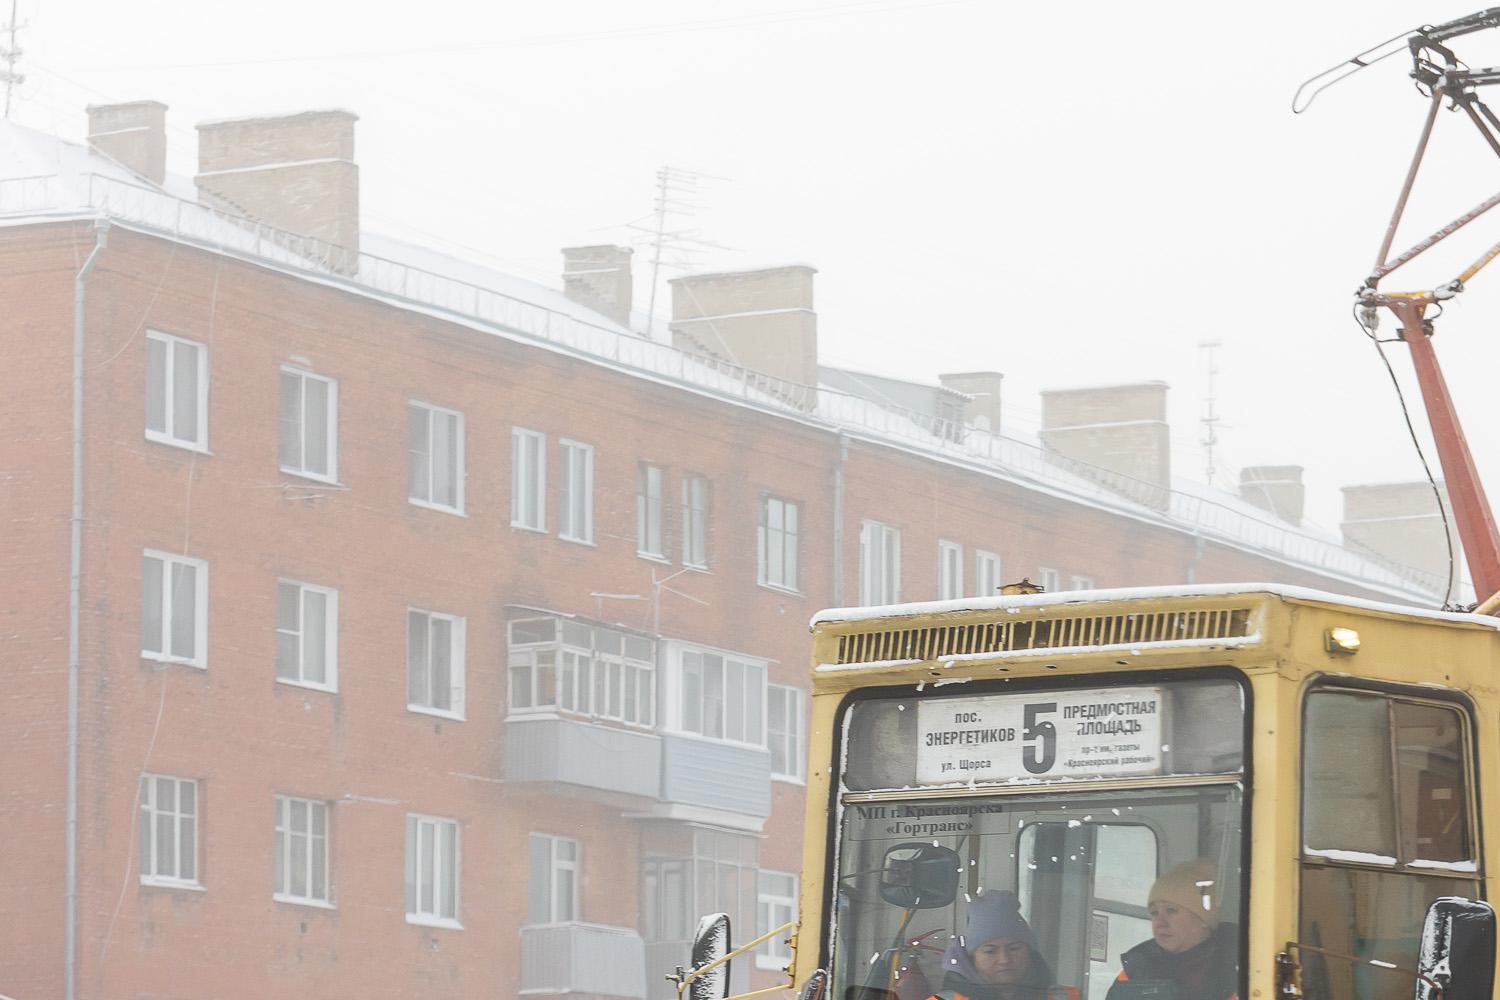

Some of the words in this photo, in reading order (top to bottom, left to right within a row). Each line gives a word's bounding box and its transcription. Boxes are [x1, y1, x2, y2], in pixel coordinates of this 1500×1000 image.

[955, 712, 982, 724] пос.
[1063, 701, 1156, 720] ПРЕДМОСТНАЯ
[925, 728, 1016, 747] ЭНЕРГЕТИКОВ
[1022, 703, 1058, 775] 5
[959, 759, 992, 771] Щорса
[856, 805, 886, 820] МП
[891, 809, 900, 819] г.
[903, 803, 1003, 820] Красноярска
[886, 820, 973, 836] «Гортранс»
